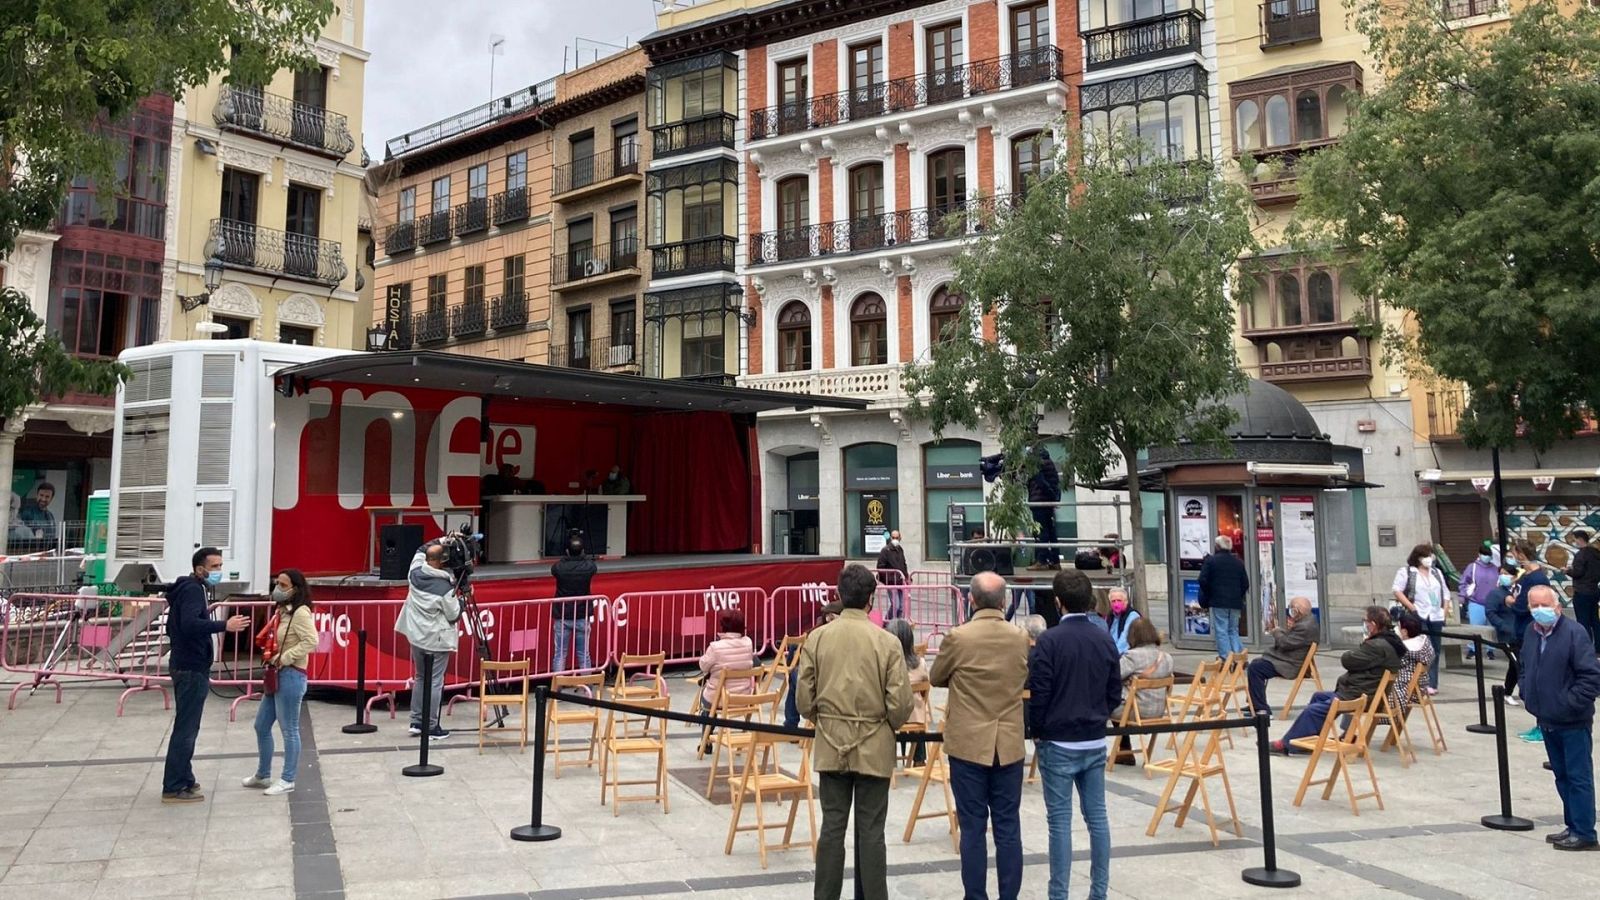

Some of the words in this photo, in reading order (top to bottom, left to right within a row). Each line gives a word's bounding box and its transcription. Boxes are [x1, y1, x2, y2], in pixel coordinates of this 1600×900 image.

[388, 287, 401, 351] HOSTAL
[273, 387, 482, 534] rne
[703, 585, 741, 612] rtve
[801, 581, 830, 606] rne
